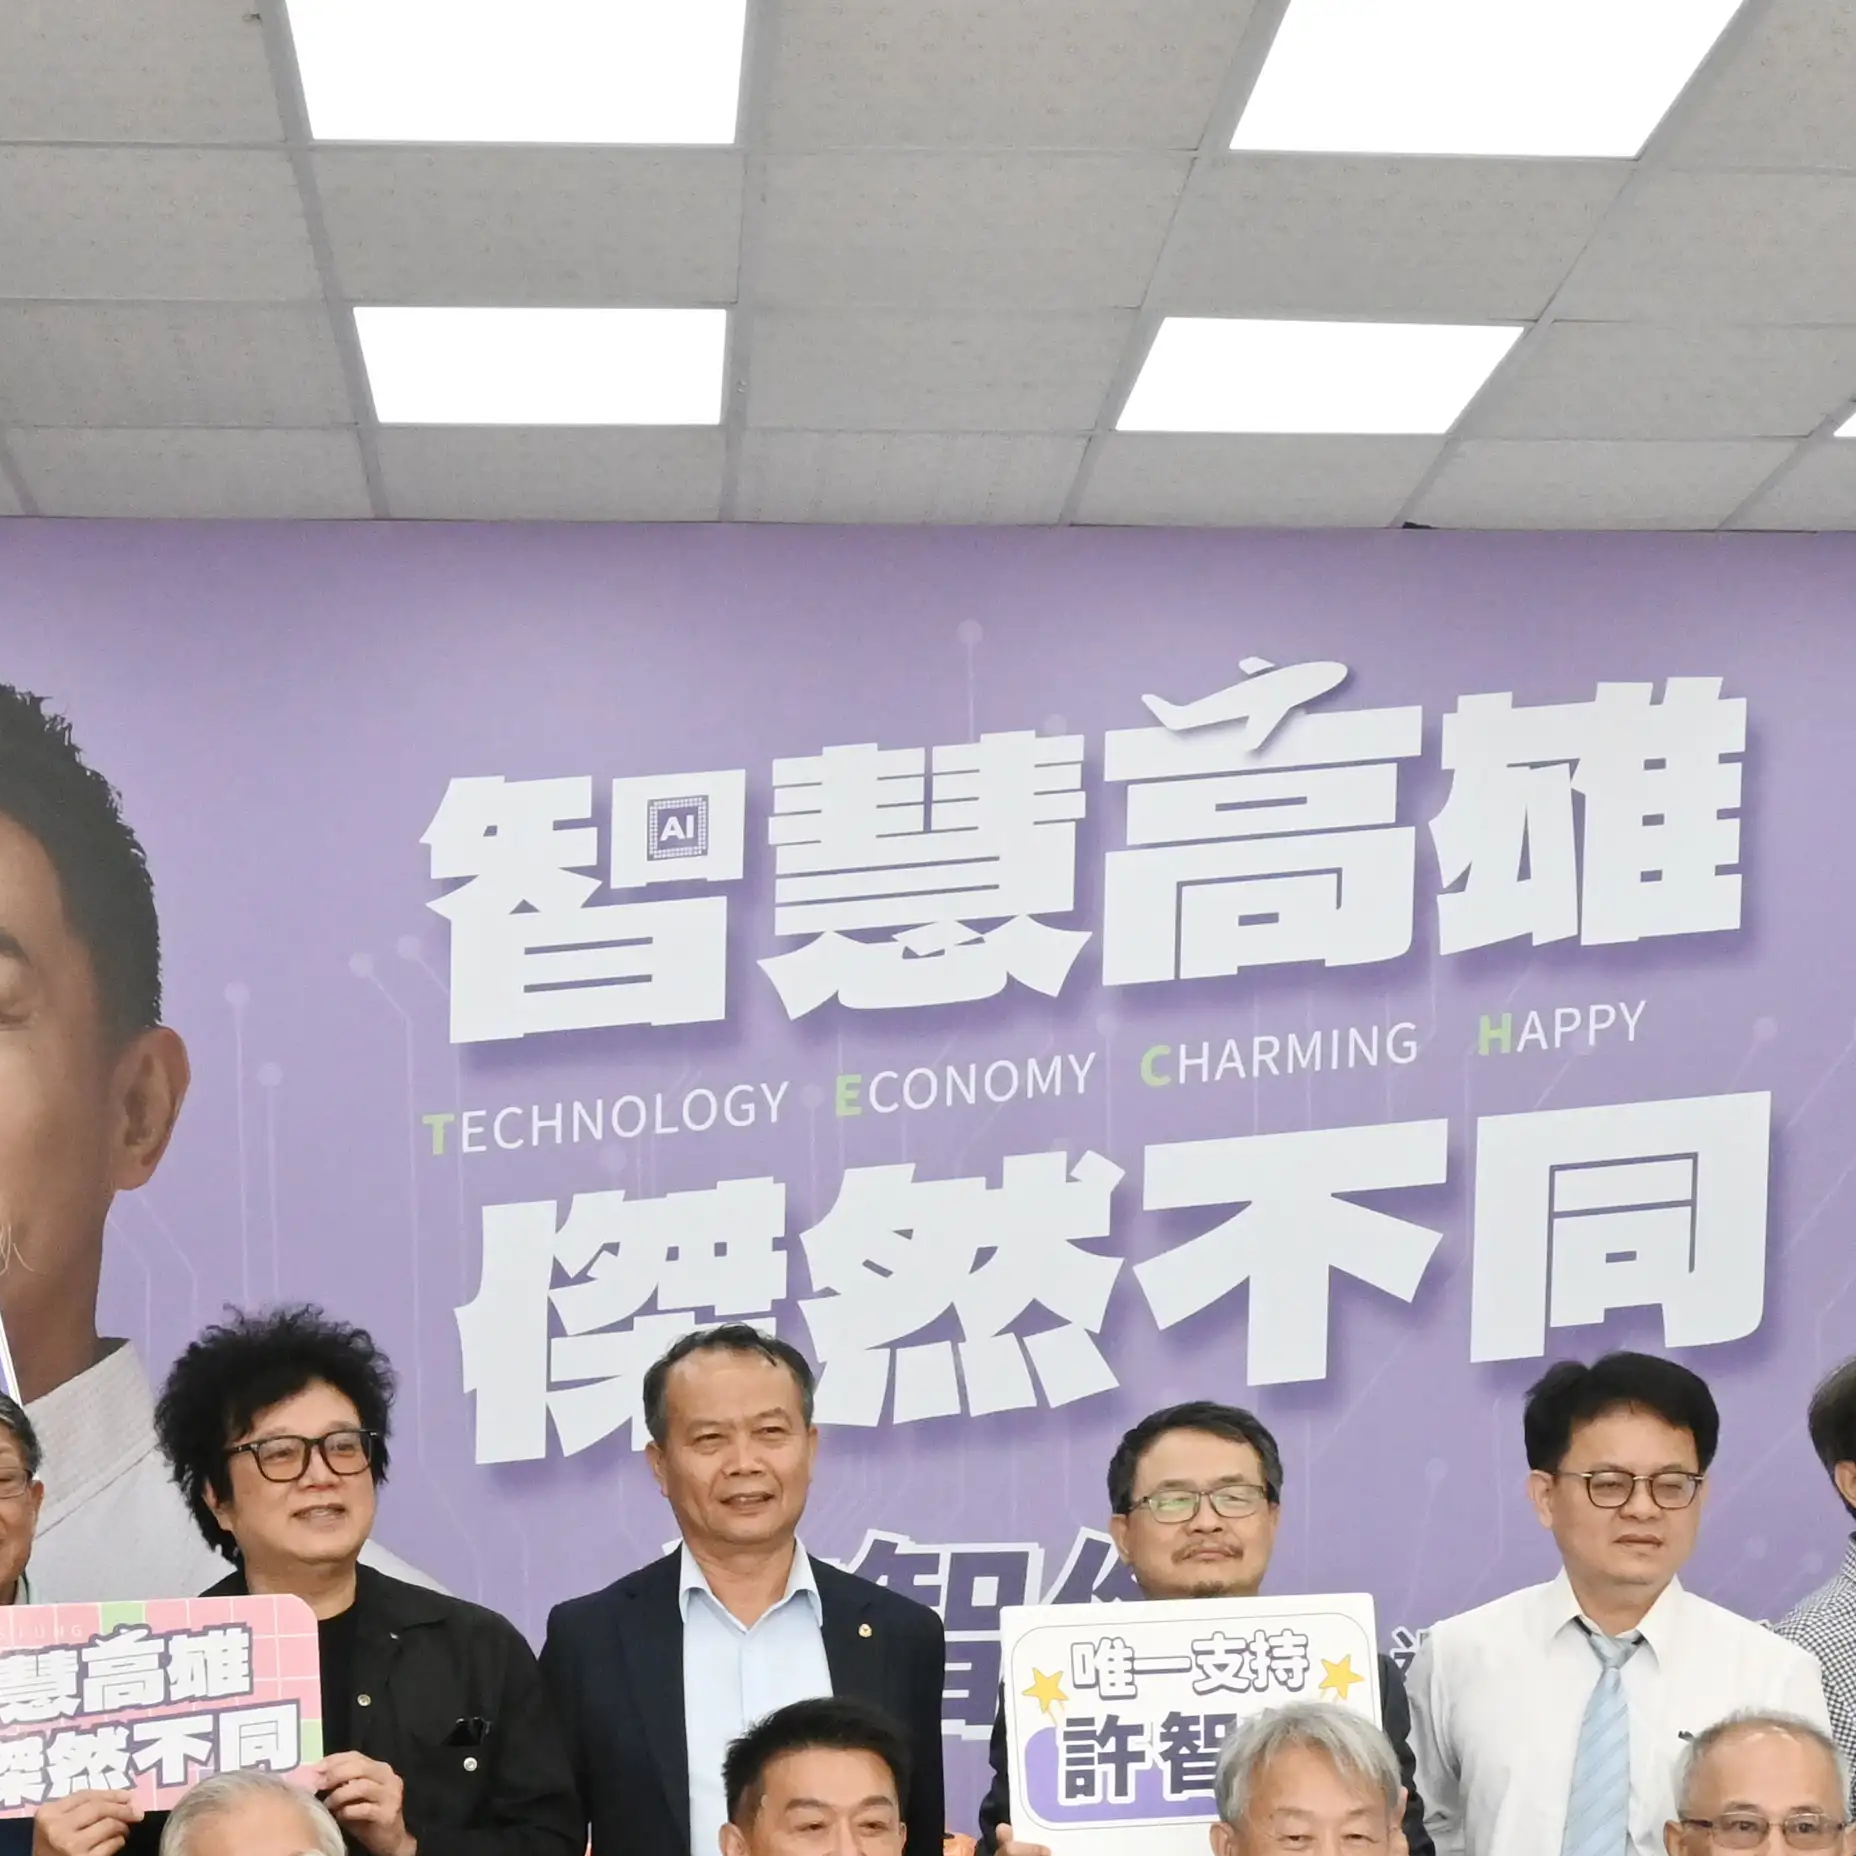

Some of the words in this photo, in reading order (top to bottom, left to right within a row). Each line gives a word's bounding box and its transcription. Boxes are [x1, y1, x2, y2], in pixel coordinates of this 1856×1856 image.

[419, 657, 1747, 1043] 智慧高雄
[660, 814, 694, 841] AI
[423, 1081, 790, 1155] TECHNOLOGY
[836, 1052, 1097, 1117] ECONOMY
[1141, 1021, 1419, 1086] CHARMING
[1478, 1000, 1646, 1056] HAPPY
[454, 1090, 1772, 1464] 傑然不同
[1070, 1629, 1311, 1700] 唯一支持
[1062, 1710, 1290, 1799] 許智
